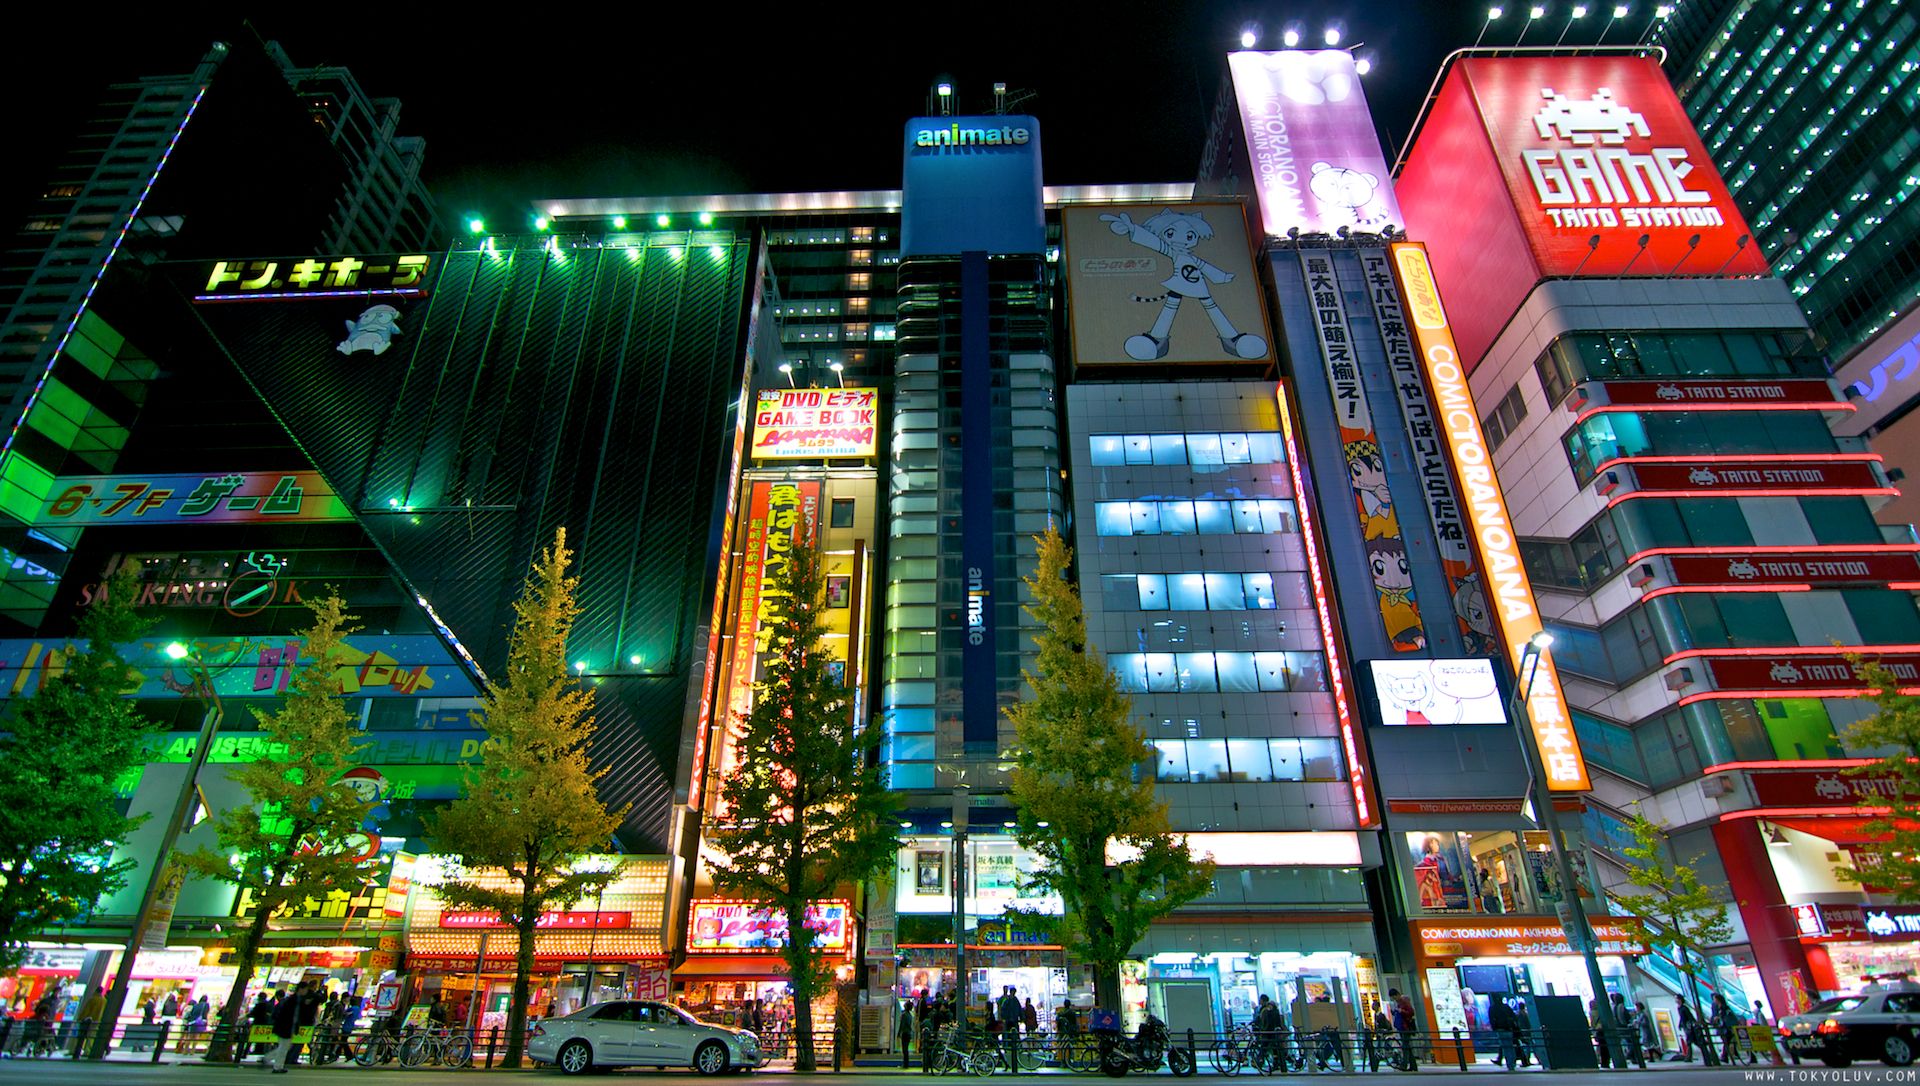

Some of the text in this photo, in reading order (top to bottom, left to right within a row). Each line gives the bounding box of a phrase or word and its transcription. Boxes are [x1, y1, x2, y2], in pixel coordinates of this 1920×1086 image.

[917, 123, 1029, 147] animate
[1520, 148, 1712, 204] GAME
[1546, 206, 1725, 228] TAITO STATION
[1852, 332, 1920, 403] ソフ
[782, 391, 875, 408] DVD ビデオ
[1683, 385, 1786, 399] TAITO STATION
[757, 409, 875, 426] GAME BOOK
[798, 439, 835, 447] ラムタラ
[1428, 344, 1532, 623] COMICTORANOANA
[1718, 469, 1825, 484] TAITO STATION
[178, 475, 303, 515] ゲーム
[1758, 562, 1870, 577] TAITO STATION
[967, 567, 990, 646] animate
[1802, 665, 1849, 680] TAITO
[716, 906, 742, 918] DVD
[1421, 928, 1521, 939] COMICTORANOANA
[1523, 928, 1567, 938] AKIHABA
[1788, 1038, 1826, 1048] POLICE
